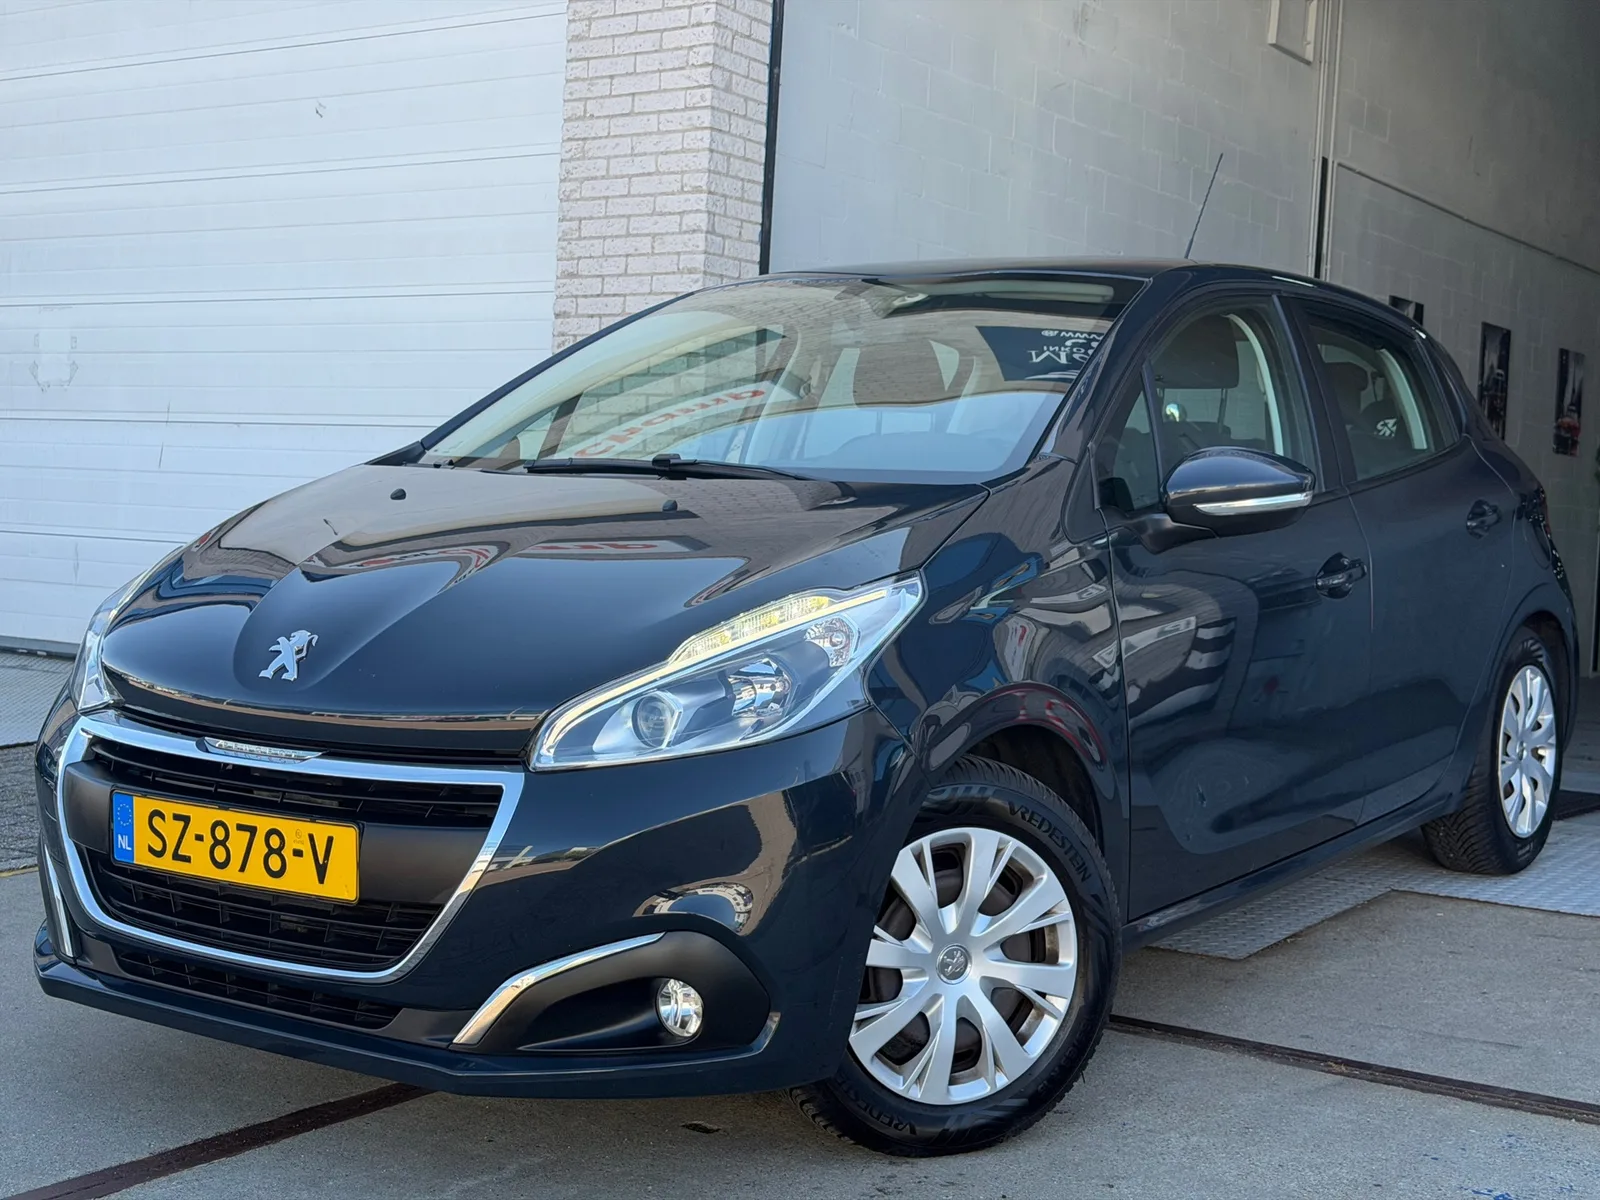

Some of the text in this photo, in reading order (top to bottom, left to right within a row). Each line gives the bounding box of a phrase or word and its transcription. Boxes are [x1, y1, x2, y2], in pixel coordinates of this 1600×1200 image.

[117, 834, 132, 851] NL
[147, 809, 335, 885] SZ-878-V
[1008, 801, 1092, 883] VREDESTEIN
